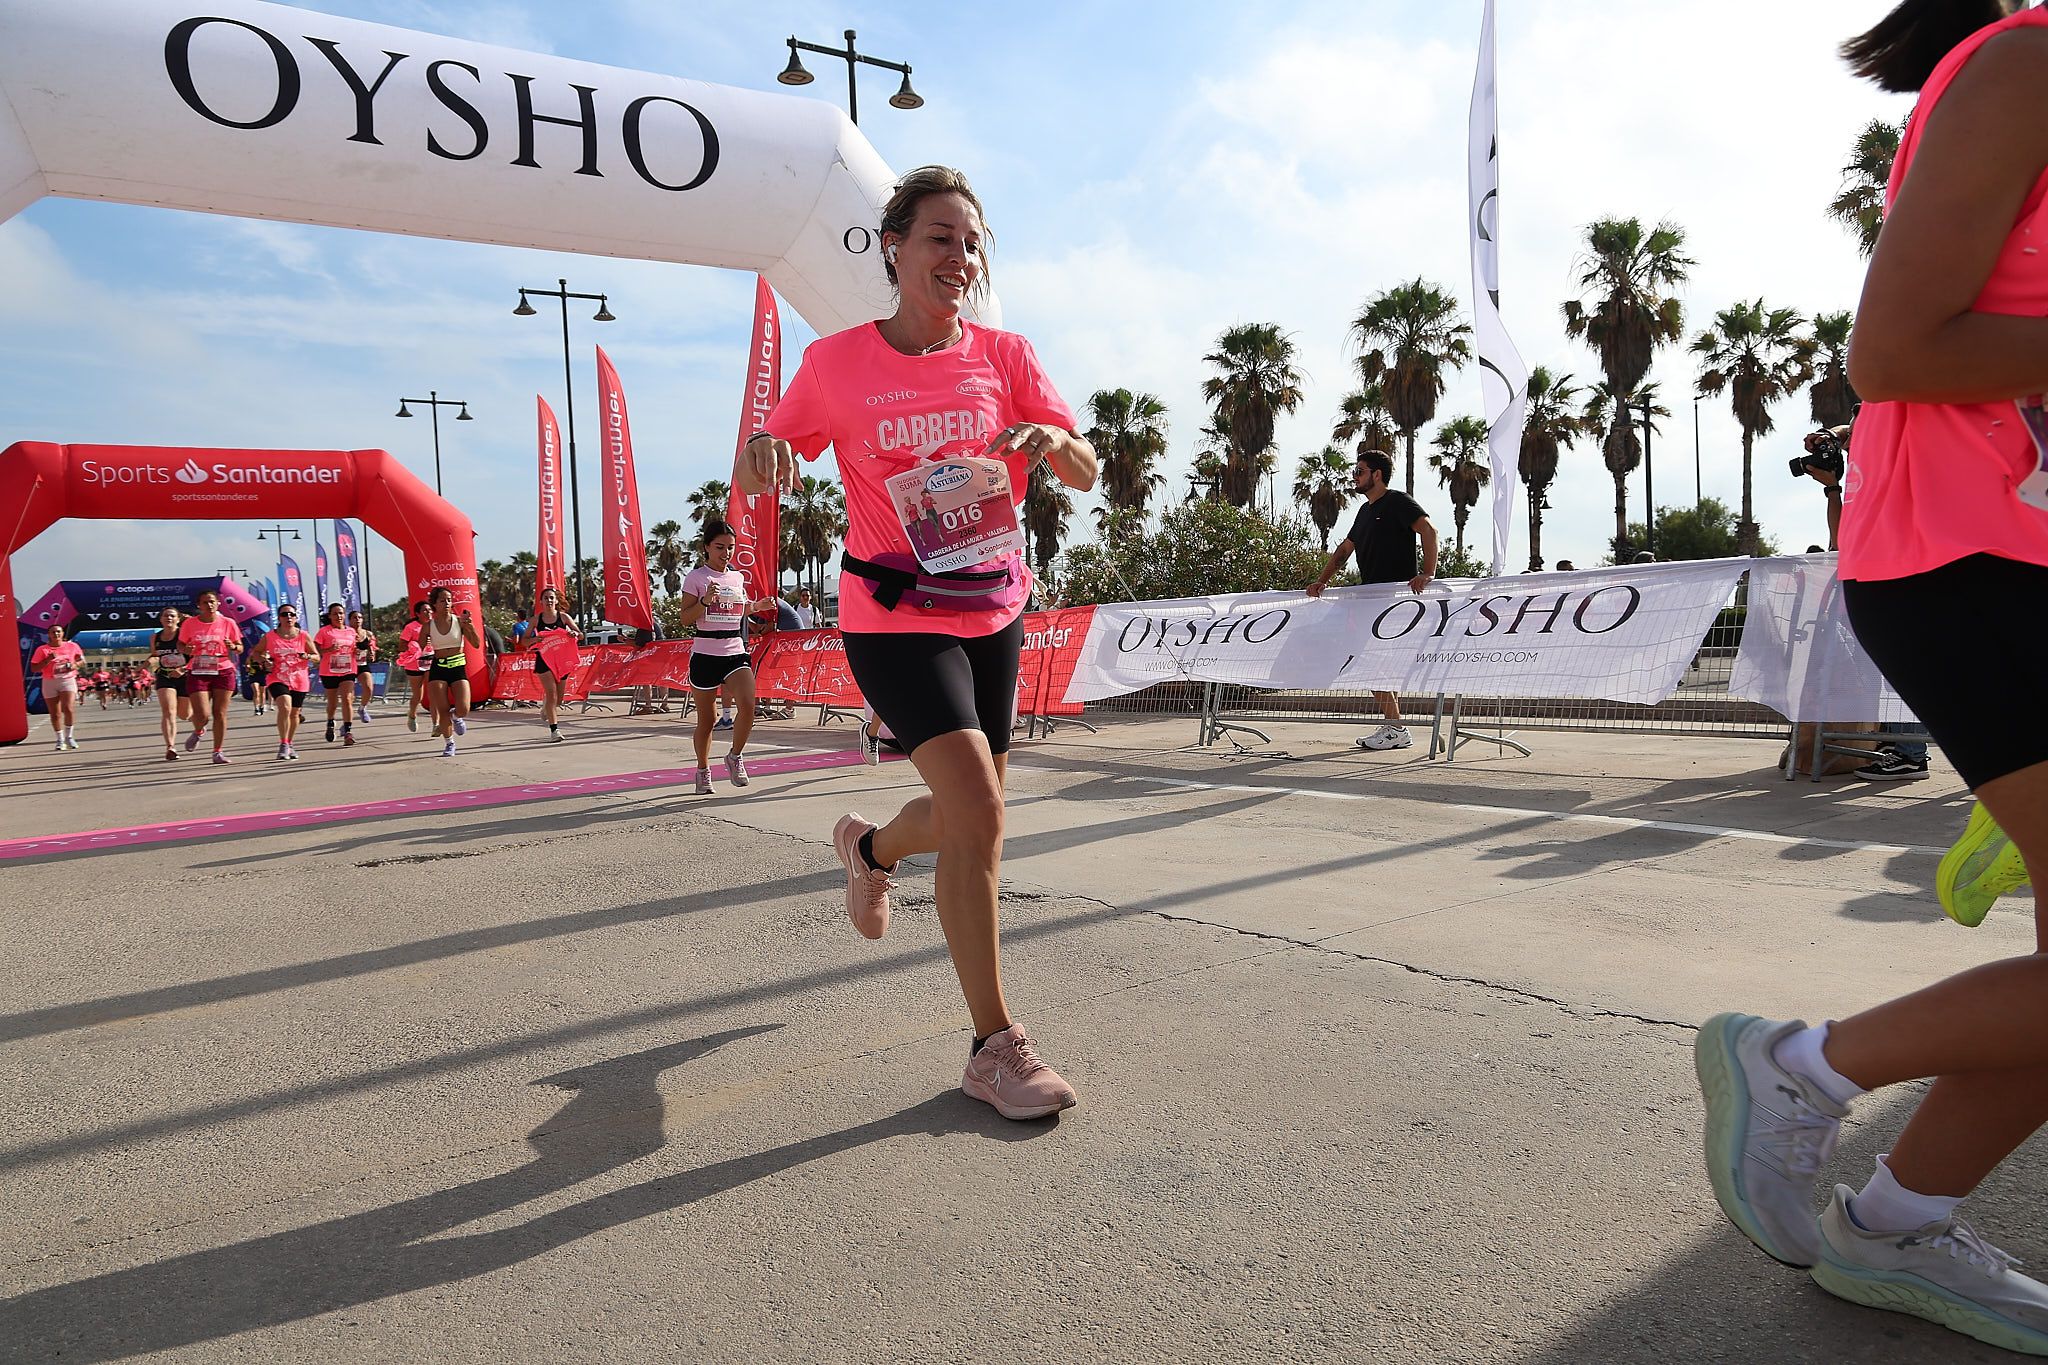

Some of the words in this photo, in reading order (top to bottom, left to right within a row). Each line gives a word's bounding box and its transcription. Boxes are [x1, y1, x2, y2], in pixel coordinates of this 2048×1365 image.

[164, 16, 720, 191] OYSHO
[866, 390, 917, 406] OYSHO
[82, 460, 170, 487] Sports
[213, 464, 341, 484] Santander
[930, 472, 970, 490] ASTURIANA
[900, 480, 923, 492] SUMA
[172, 492, 258, 502] sportssantander.es
[942, 503, 983, 530] 016
[928, 545, 952, 559] CARRERA
[952, 542, 960, 550] DE
[960, 540, 967, 548] LA
[967, 534, 983, 546] MUJER
[987, 525, 1010, 538] VALENCIA
[958, 527, 977, 539] 2360
[935, 554, 968, 569] OYSHO
[984, 540, 1013, 554] Santander
[432, 562, 464, 572] Sports
[87, 611, 160, 620] VOLV
[1371, 585, 1641, 640] OYSHO
[1021, 626, 1072, 650] ander
[1117, 609, 1291, 653] OYSHO
[1143, 656, 1219, 672] WWW.OYSHO.COM
[1415, 651, 1539, 663] WWW.OYSHO.COM
